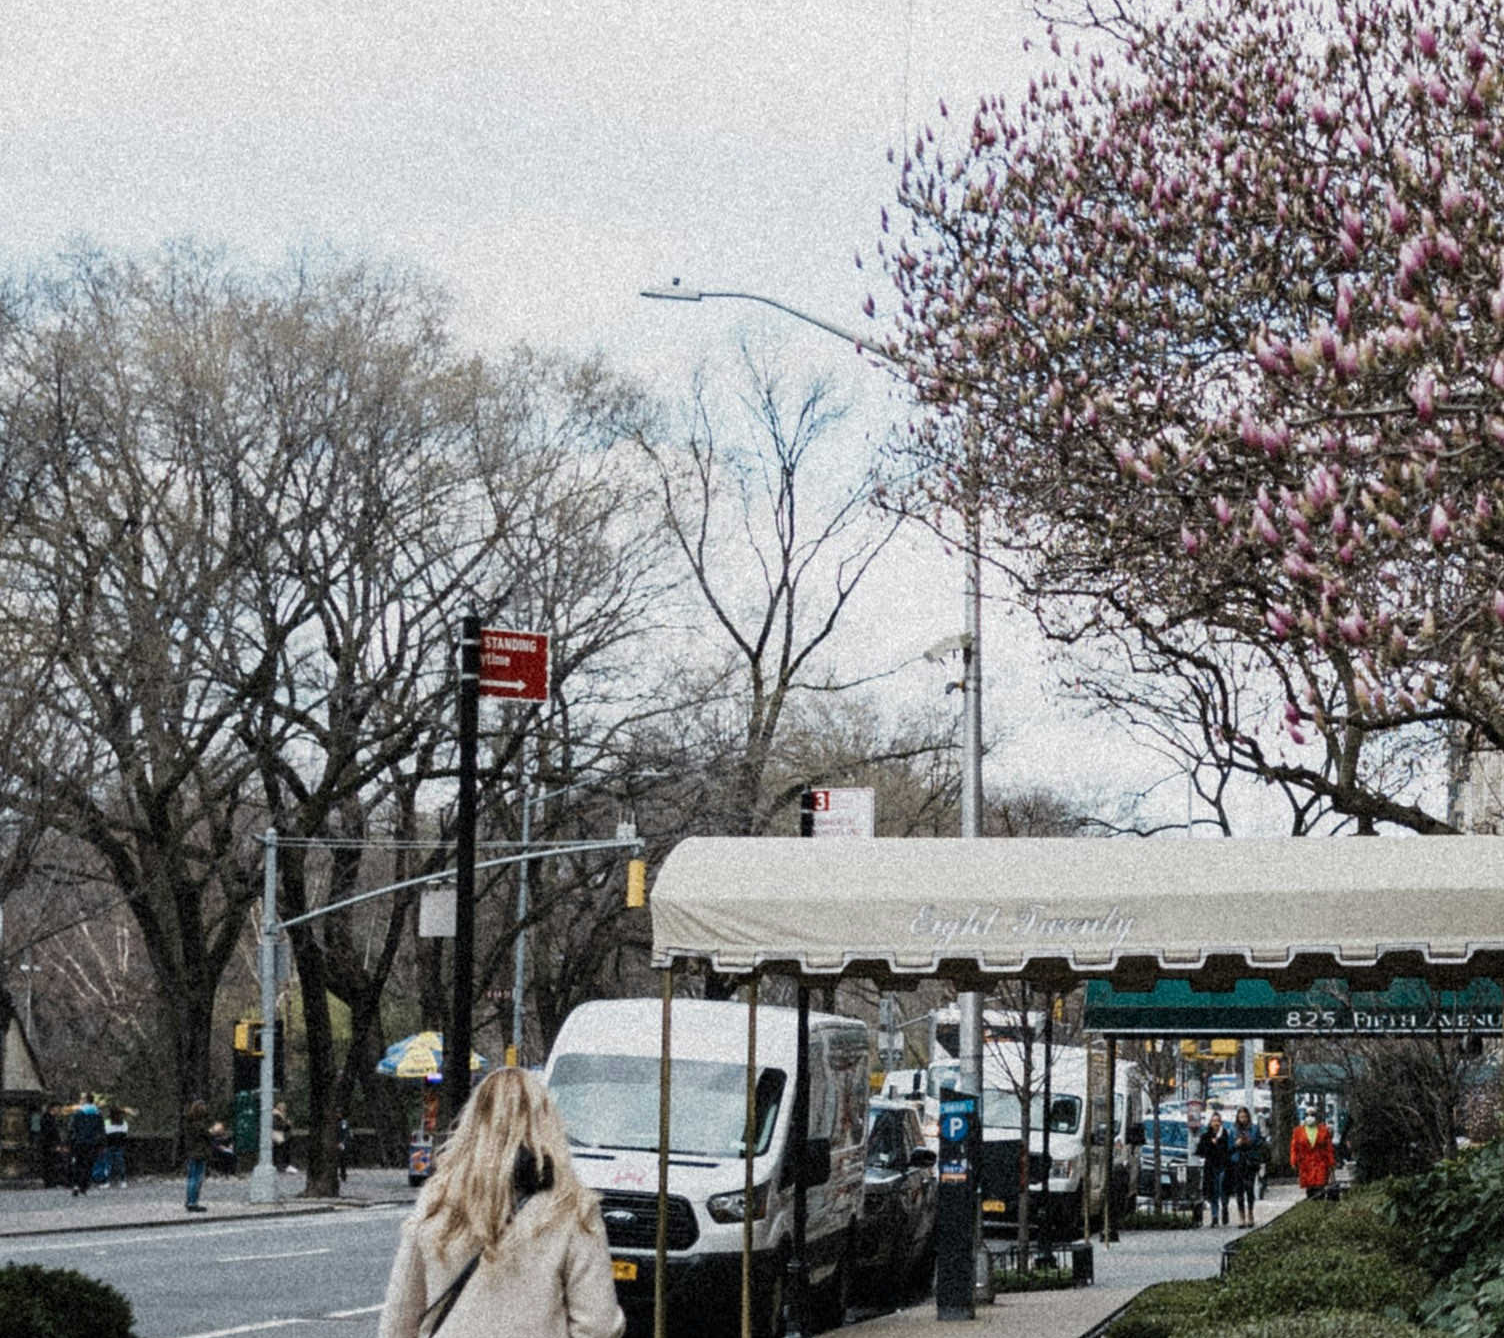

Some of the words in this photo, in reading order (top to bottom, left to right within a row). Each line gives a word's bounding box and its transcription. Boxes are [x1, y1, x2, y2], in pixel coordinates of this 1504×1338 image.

[484, 636, 537, 654] STANDING
[480, 652, 511, 668] ytime
[815, 792, 826, 811] 3
[909, 904, 1001, 945] Eight
[1012, 903, 1136, 948] Twenty
[1285, 1011, 1336, 1028] 825
[1353, 1011, 1417, 1029] FIFTH
[1425, 1012, 1504, 1028] AVENU
[949, 1117, 964, 1138] P
